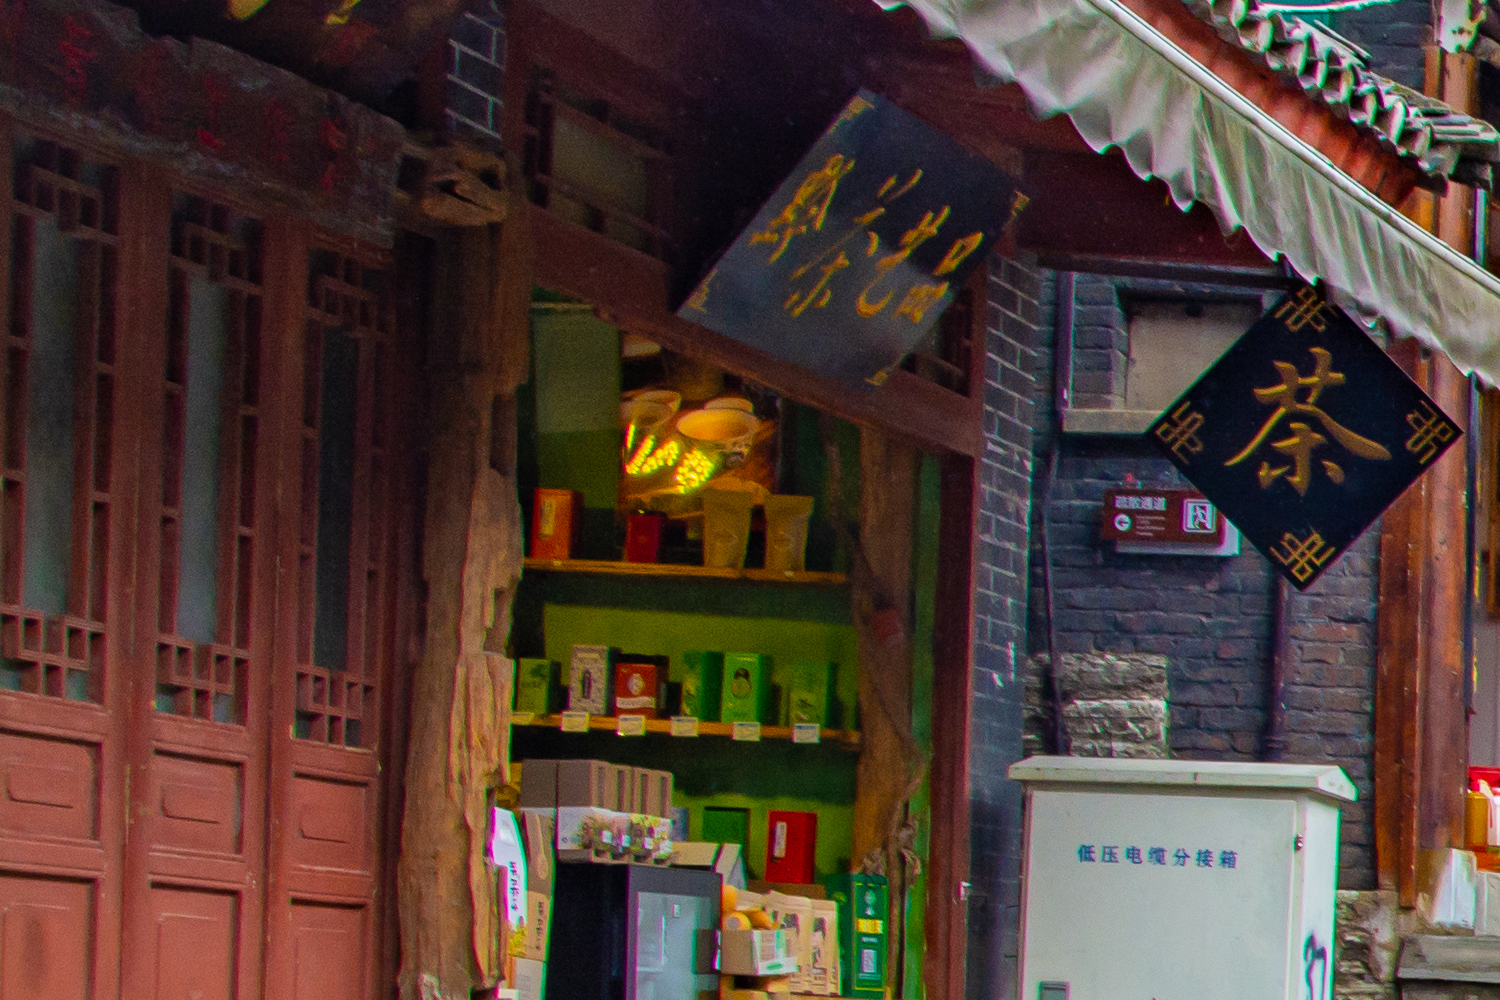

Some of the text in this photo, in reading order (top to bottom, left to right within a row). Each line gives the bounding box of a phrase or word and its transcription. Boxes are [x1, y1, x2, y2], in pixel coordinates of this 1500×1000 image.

[1224, 346, 1393, 498] 茶
[1077, 844, 1238, 869] 低压电缆分接箱
